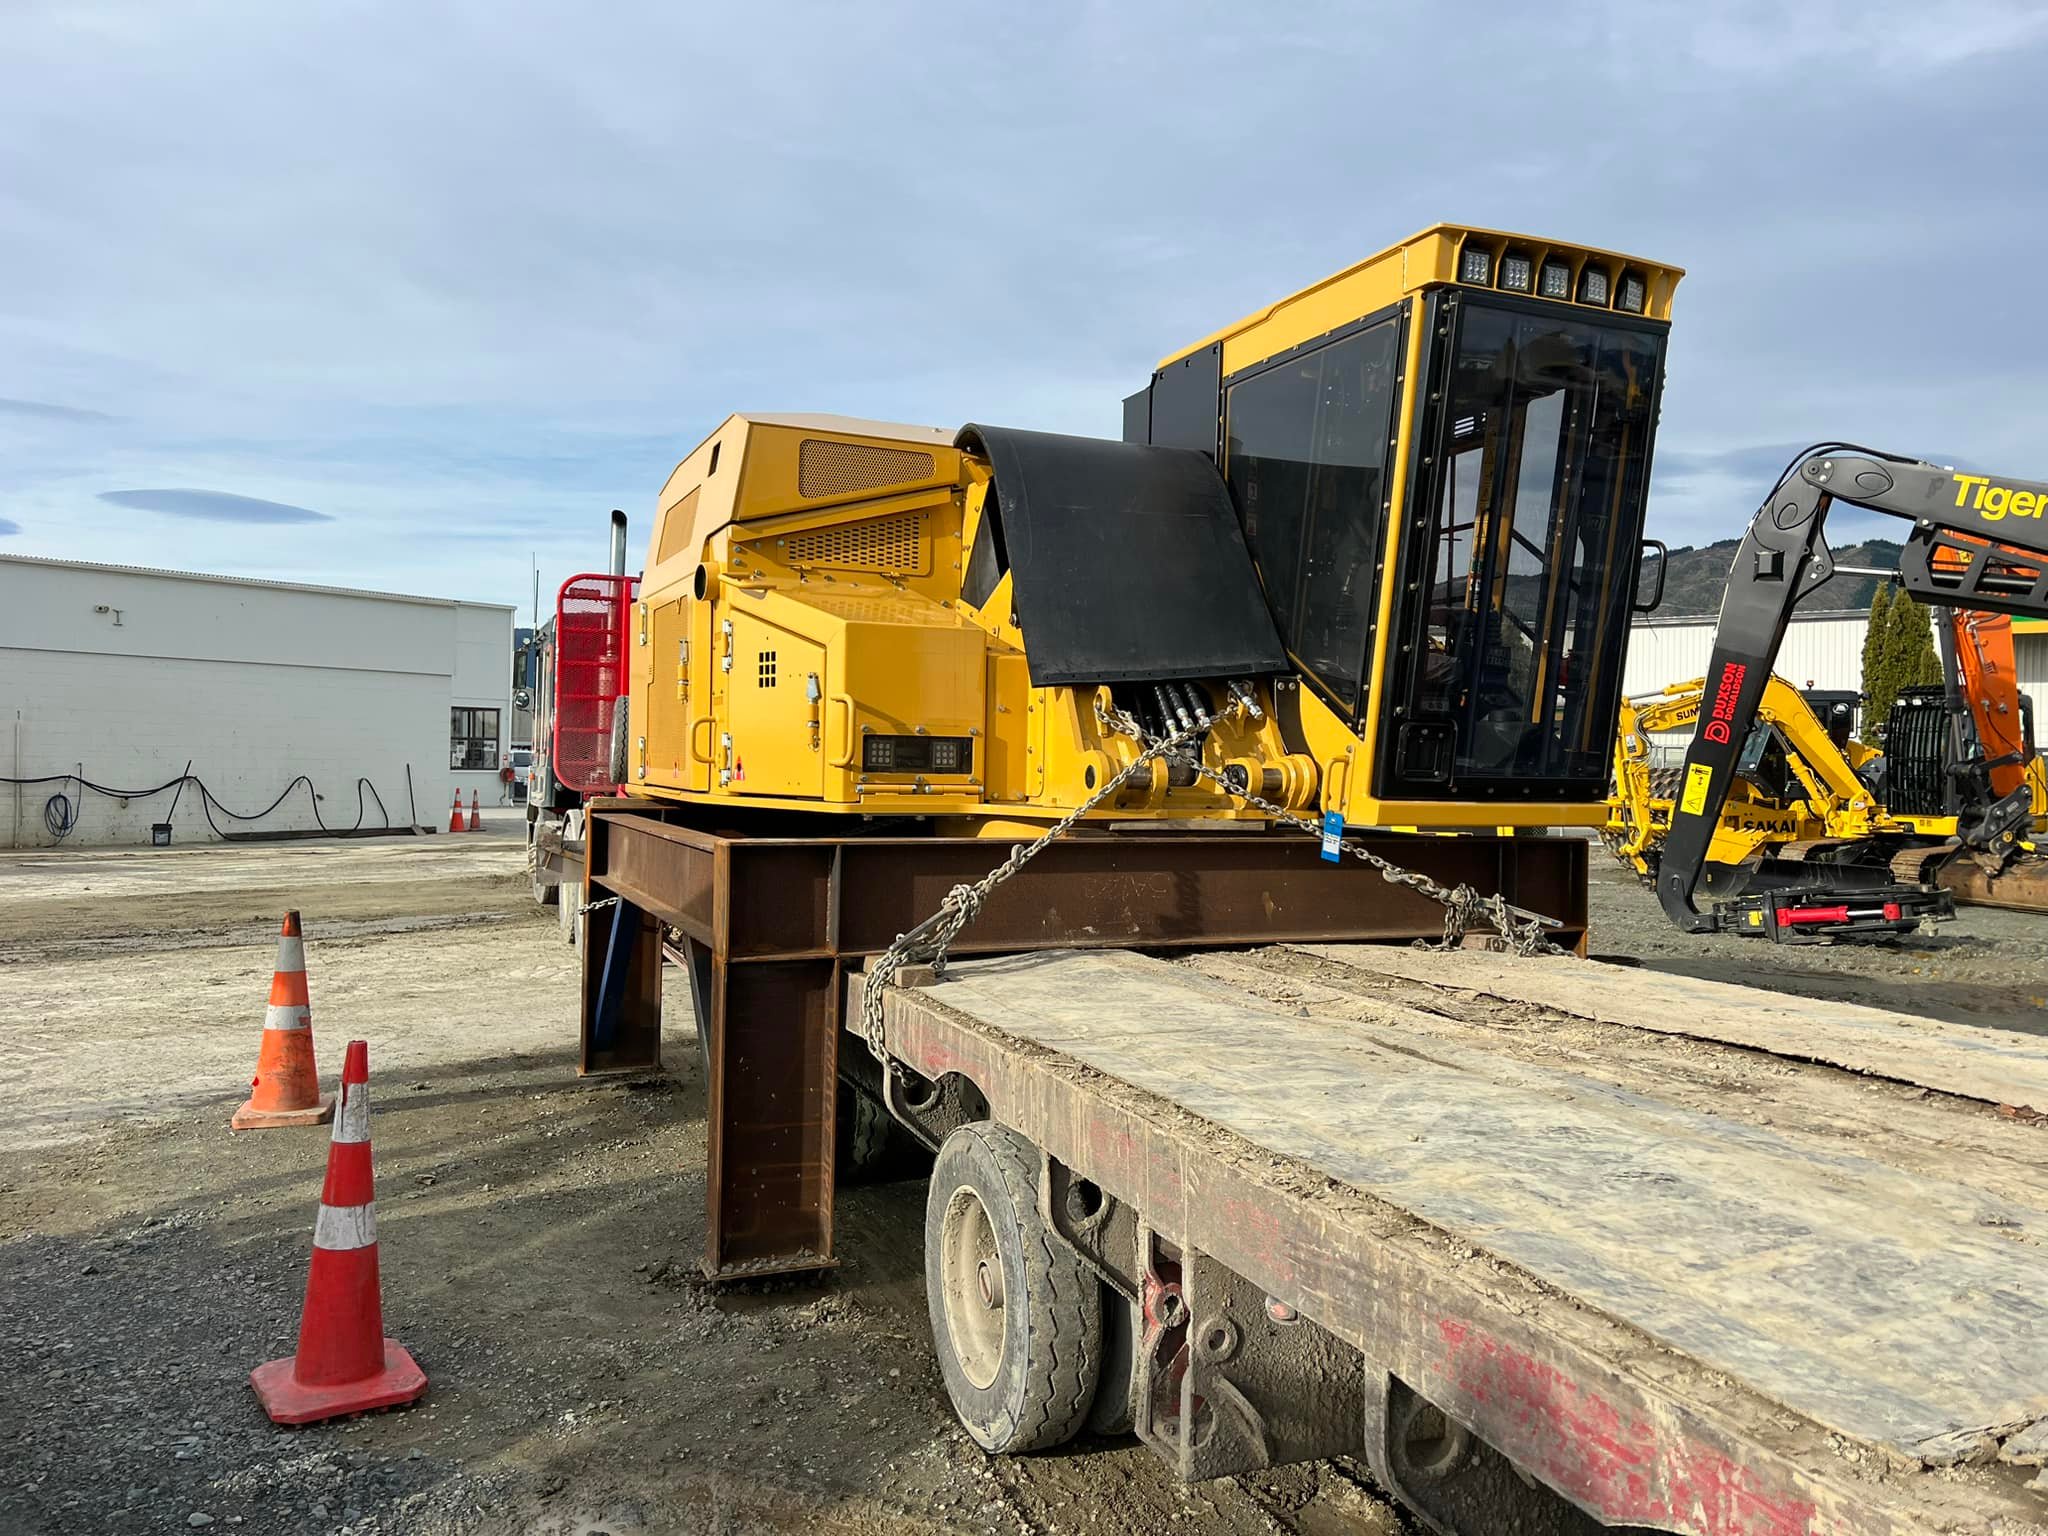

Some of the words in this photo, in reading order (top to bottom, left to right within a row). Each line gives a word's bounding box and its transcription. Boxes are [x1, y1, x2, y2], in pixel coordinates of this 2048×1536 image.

[1953, 474, 2048, 520] Tiger
[1712, 662, 1736, 718] DUXSON
[1725, 664, 1746, 720] DONALDSON
[1744, 820, 1795, 832] SAKAI
